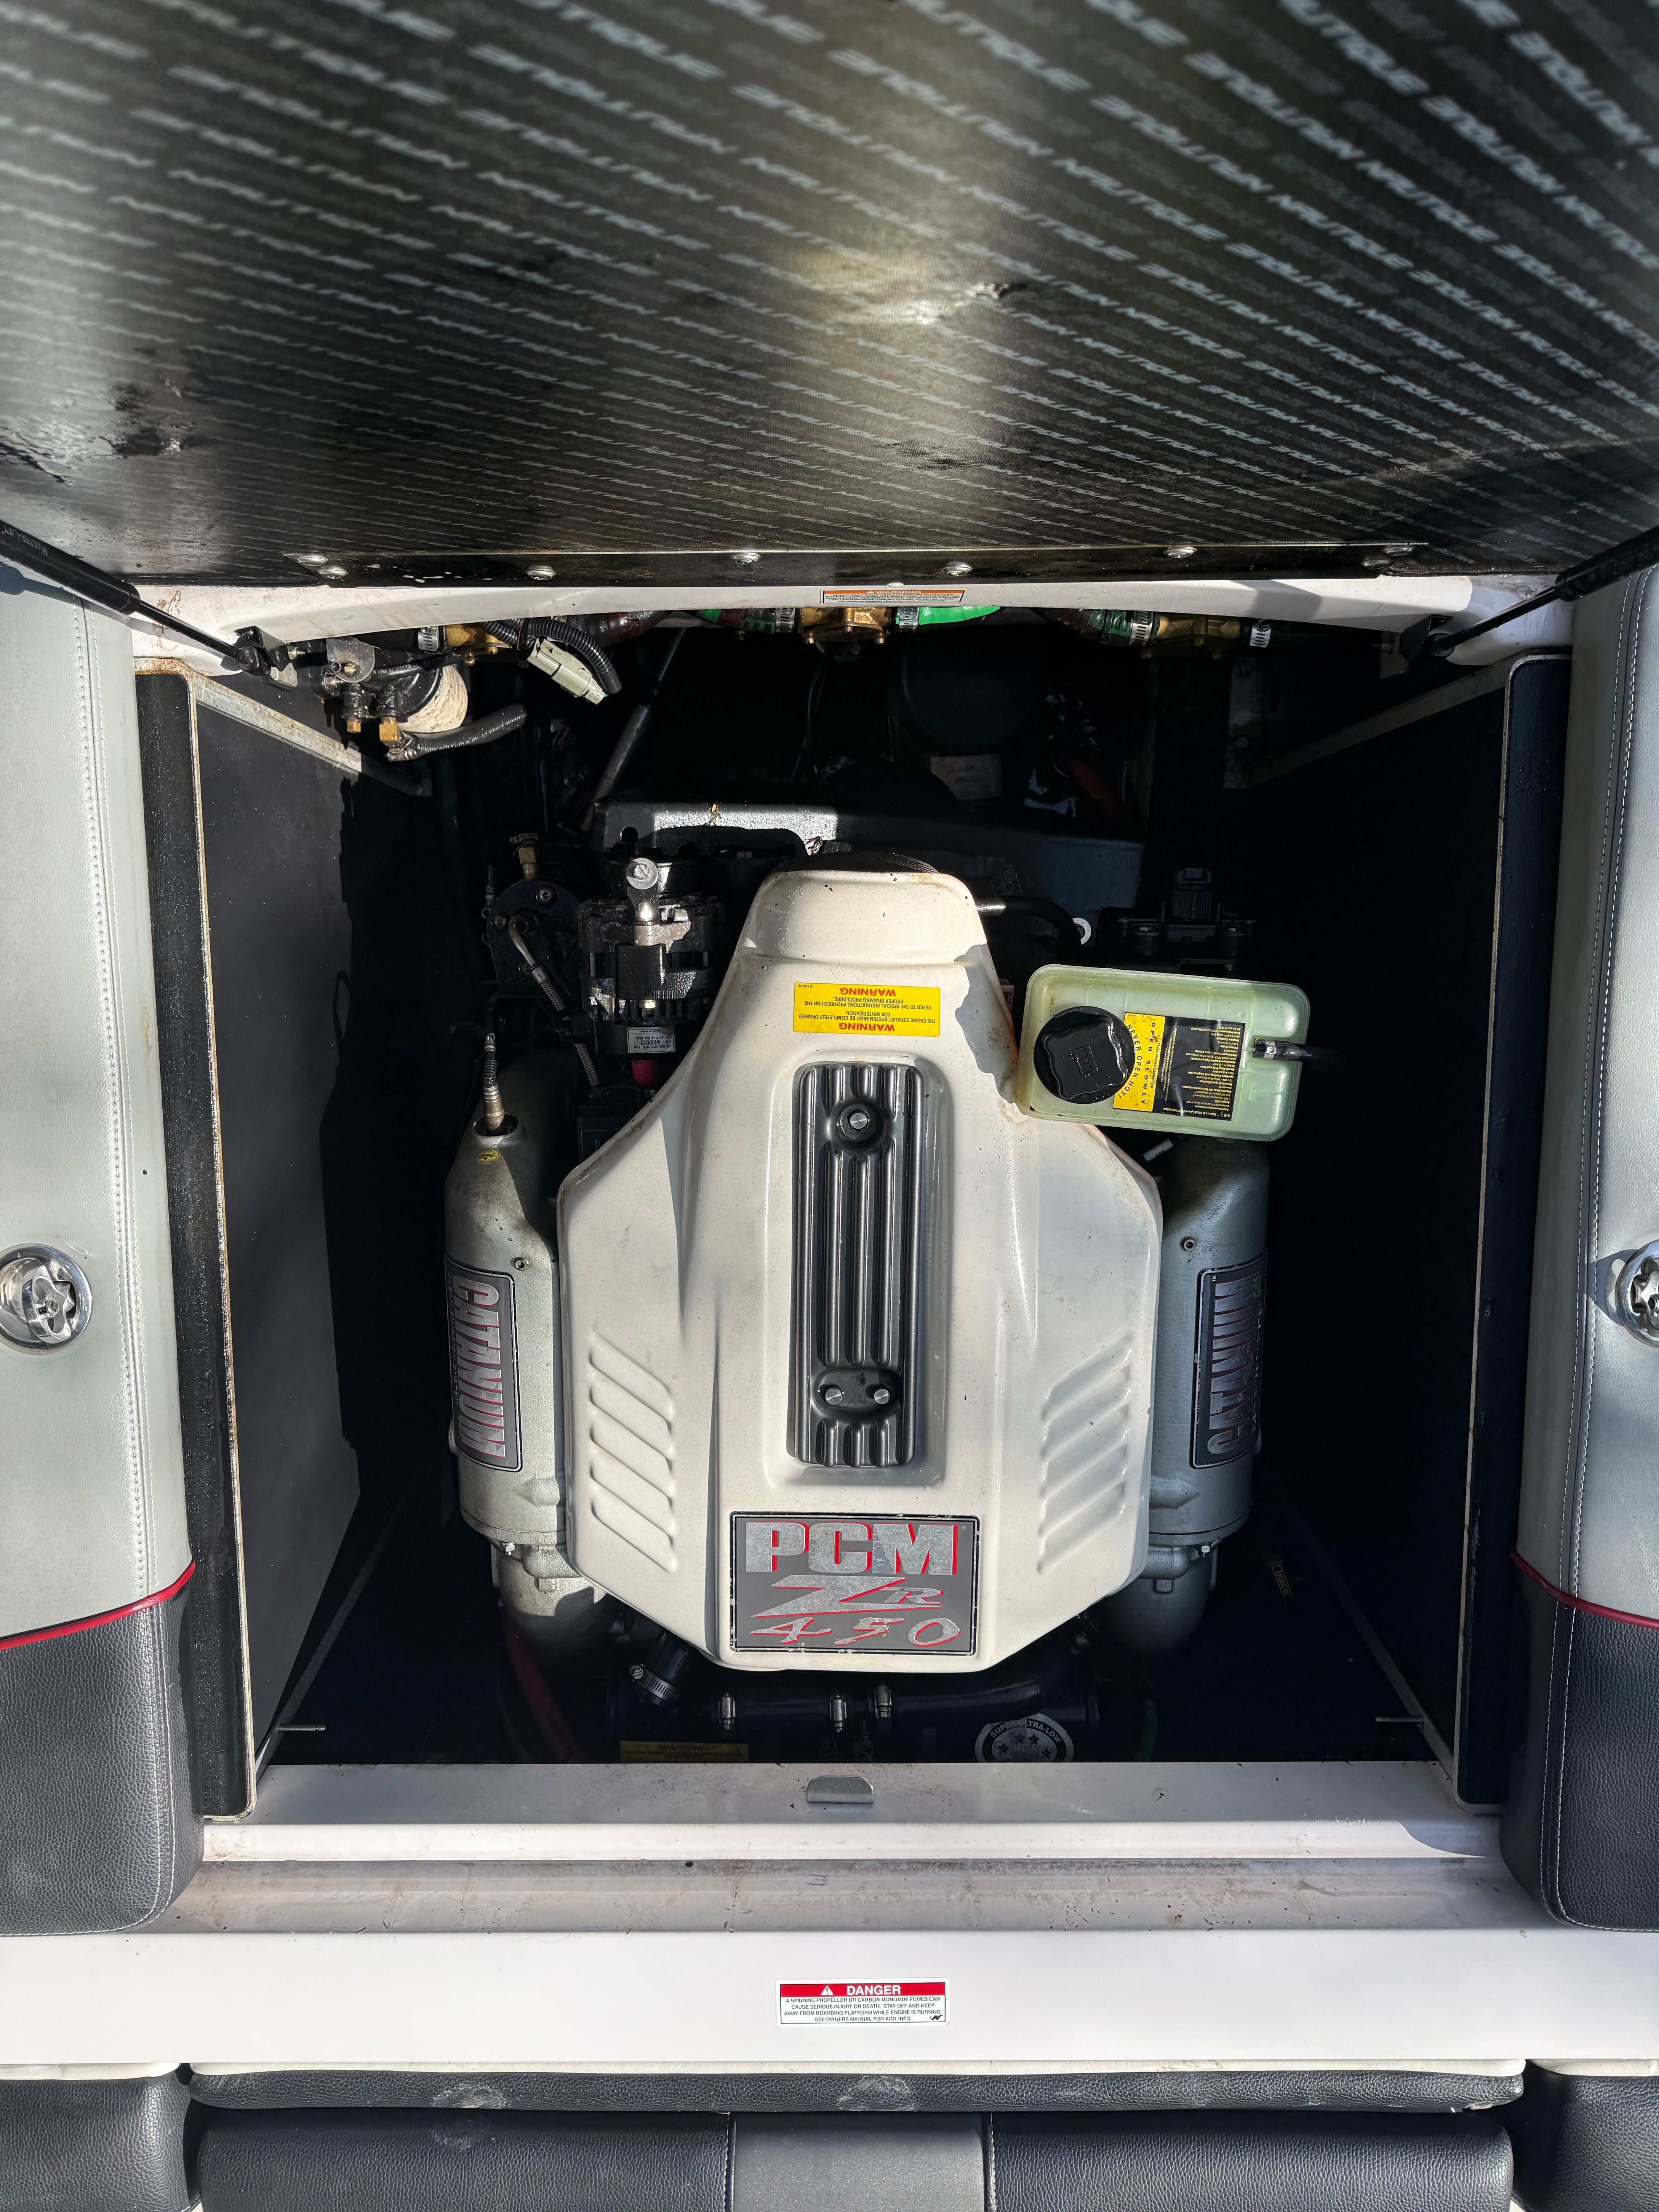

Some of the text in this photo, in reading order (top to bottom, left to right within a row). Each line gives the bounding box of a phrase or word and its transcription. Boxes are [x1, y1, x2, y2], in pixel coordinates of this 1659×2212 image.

[840, 988, 896, 996] WARNING
[839, 1023, 895, 1032] WARNING
[1118, 1024, 1142, 1098] NEVER OPEN HOT!
[1141, 1060, 1151, 1104] SLOWLY
[453, 1275, 505, 1459] CATANIUM
[1207, 1271, 1257, 1455] CATANIUM
[745, 1522, 958, 1575] PCM
[749, 1616, 961, 1647] 450
[847, 1985, 901, 1995] DANGER
